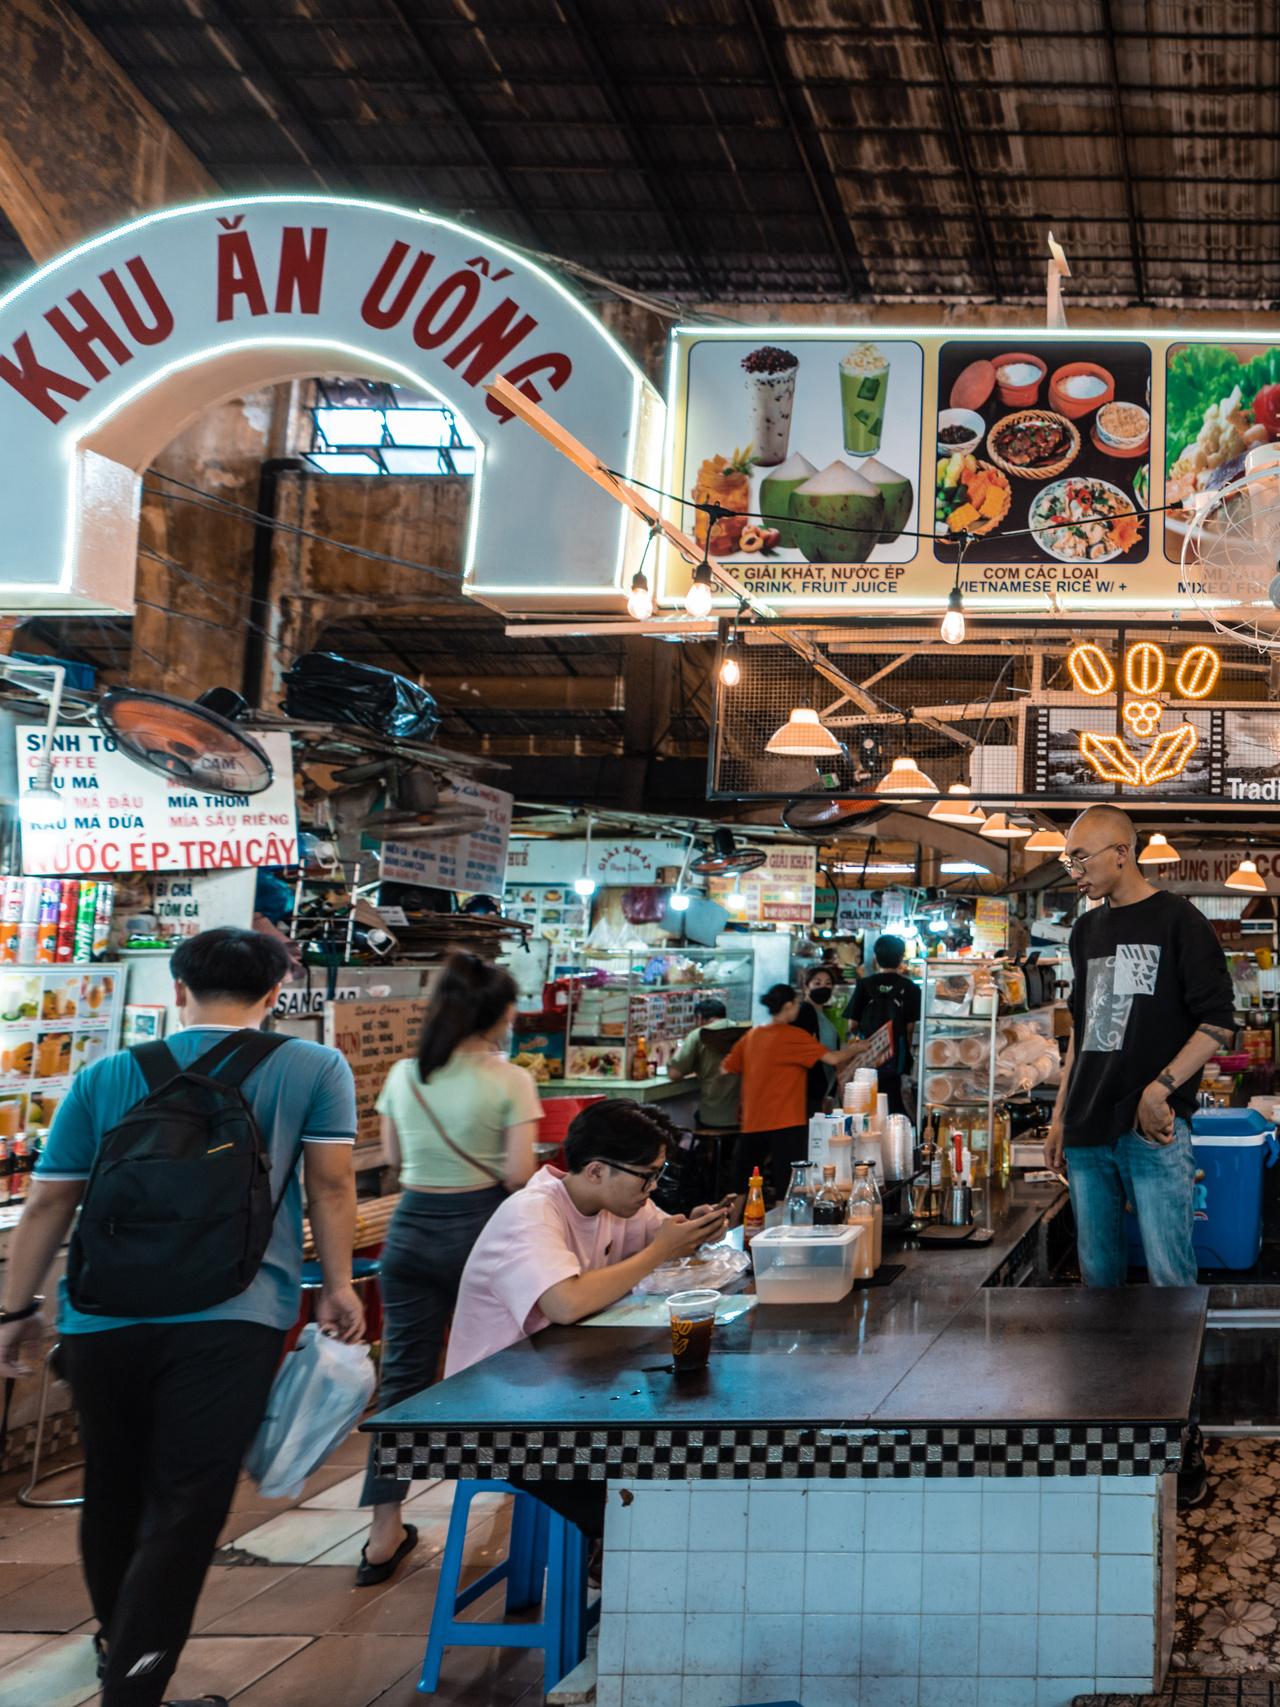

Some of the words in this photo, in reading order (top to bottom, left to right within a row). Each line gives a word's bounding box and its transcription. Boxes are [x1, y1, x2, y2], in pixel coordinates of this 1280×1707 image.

[0, 255, 174, 425] KHU
[216, 214, 328, 323] ĂN
[361, 240, 573, 425] UỐNG
[744, 565, 776, 580] GIẢI
[837, 565, 880, 580] NƯỚC
[885, 564, 905, 580] ÉP
[983, 567, 1020, 580] CƠM
[1025, 565, 1057, 580] CÁC
[1062, 567, 1098, 583] LOẠI
[744, 581, 796, 594] DRINK,
[802, 582, 847, 593] FRUIT
[852, 582, 897, 593] JUICE
[958, 581, 1050, 593] VIETNAMESE
[1056, 581, 1091, 593] RICE
[1096, 581, 1114, 593] W/
[1178, 582, 1229, 594] MIXED
[26, 734, 80, 752] SINH
[28, 756, 98, 769] CFFEE
[201, 757, 237, 771] CAM
[72, 773, 99, 789] MÁ
[168, 794, 199, 808] MÍA
[75, 814, 101, 829] MÁ
[169, 812, 199, 828] MÍA
[276, 991, 324, 1015] SANG
